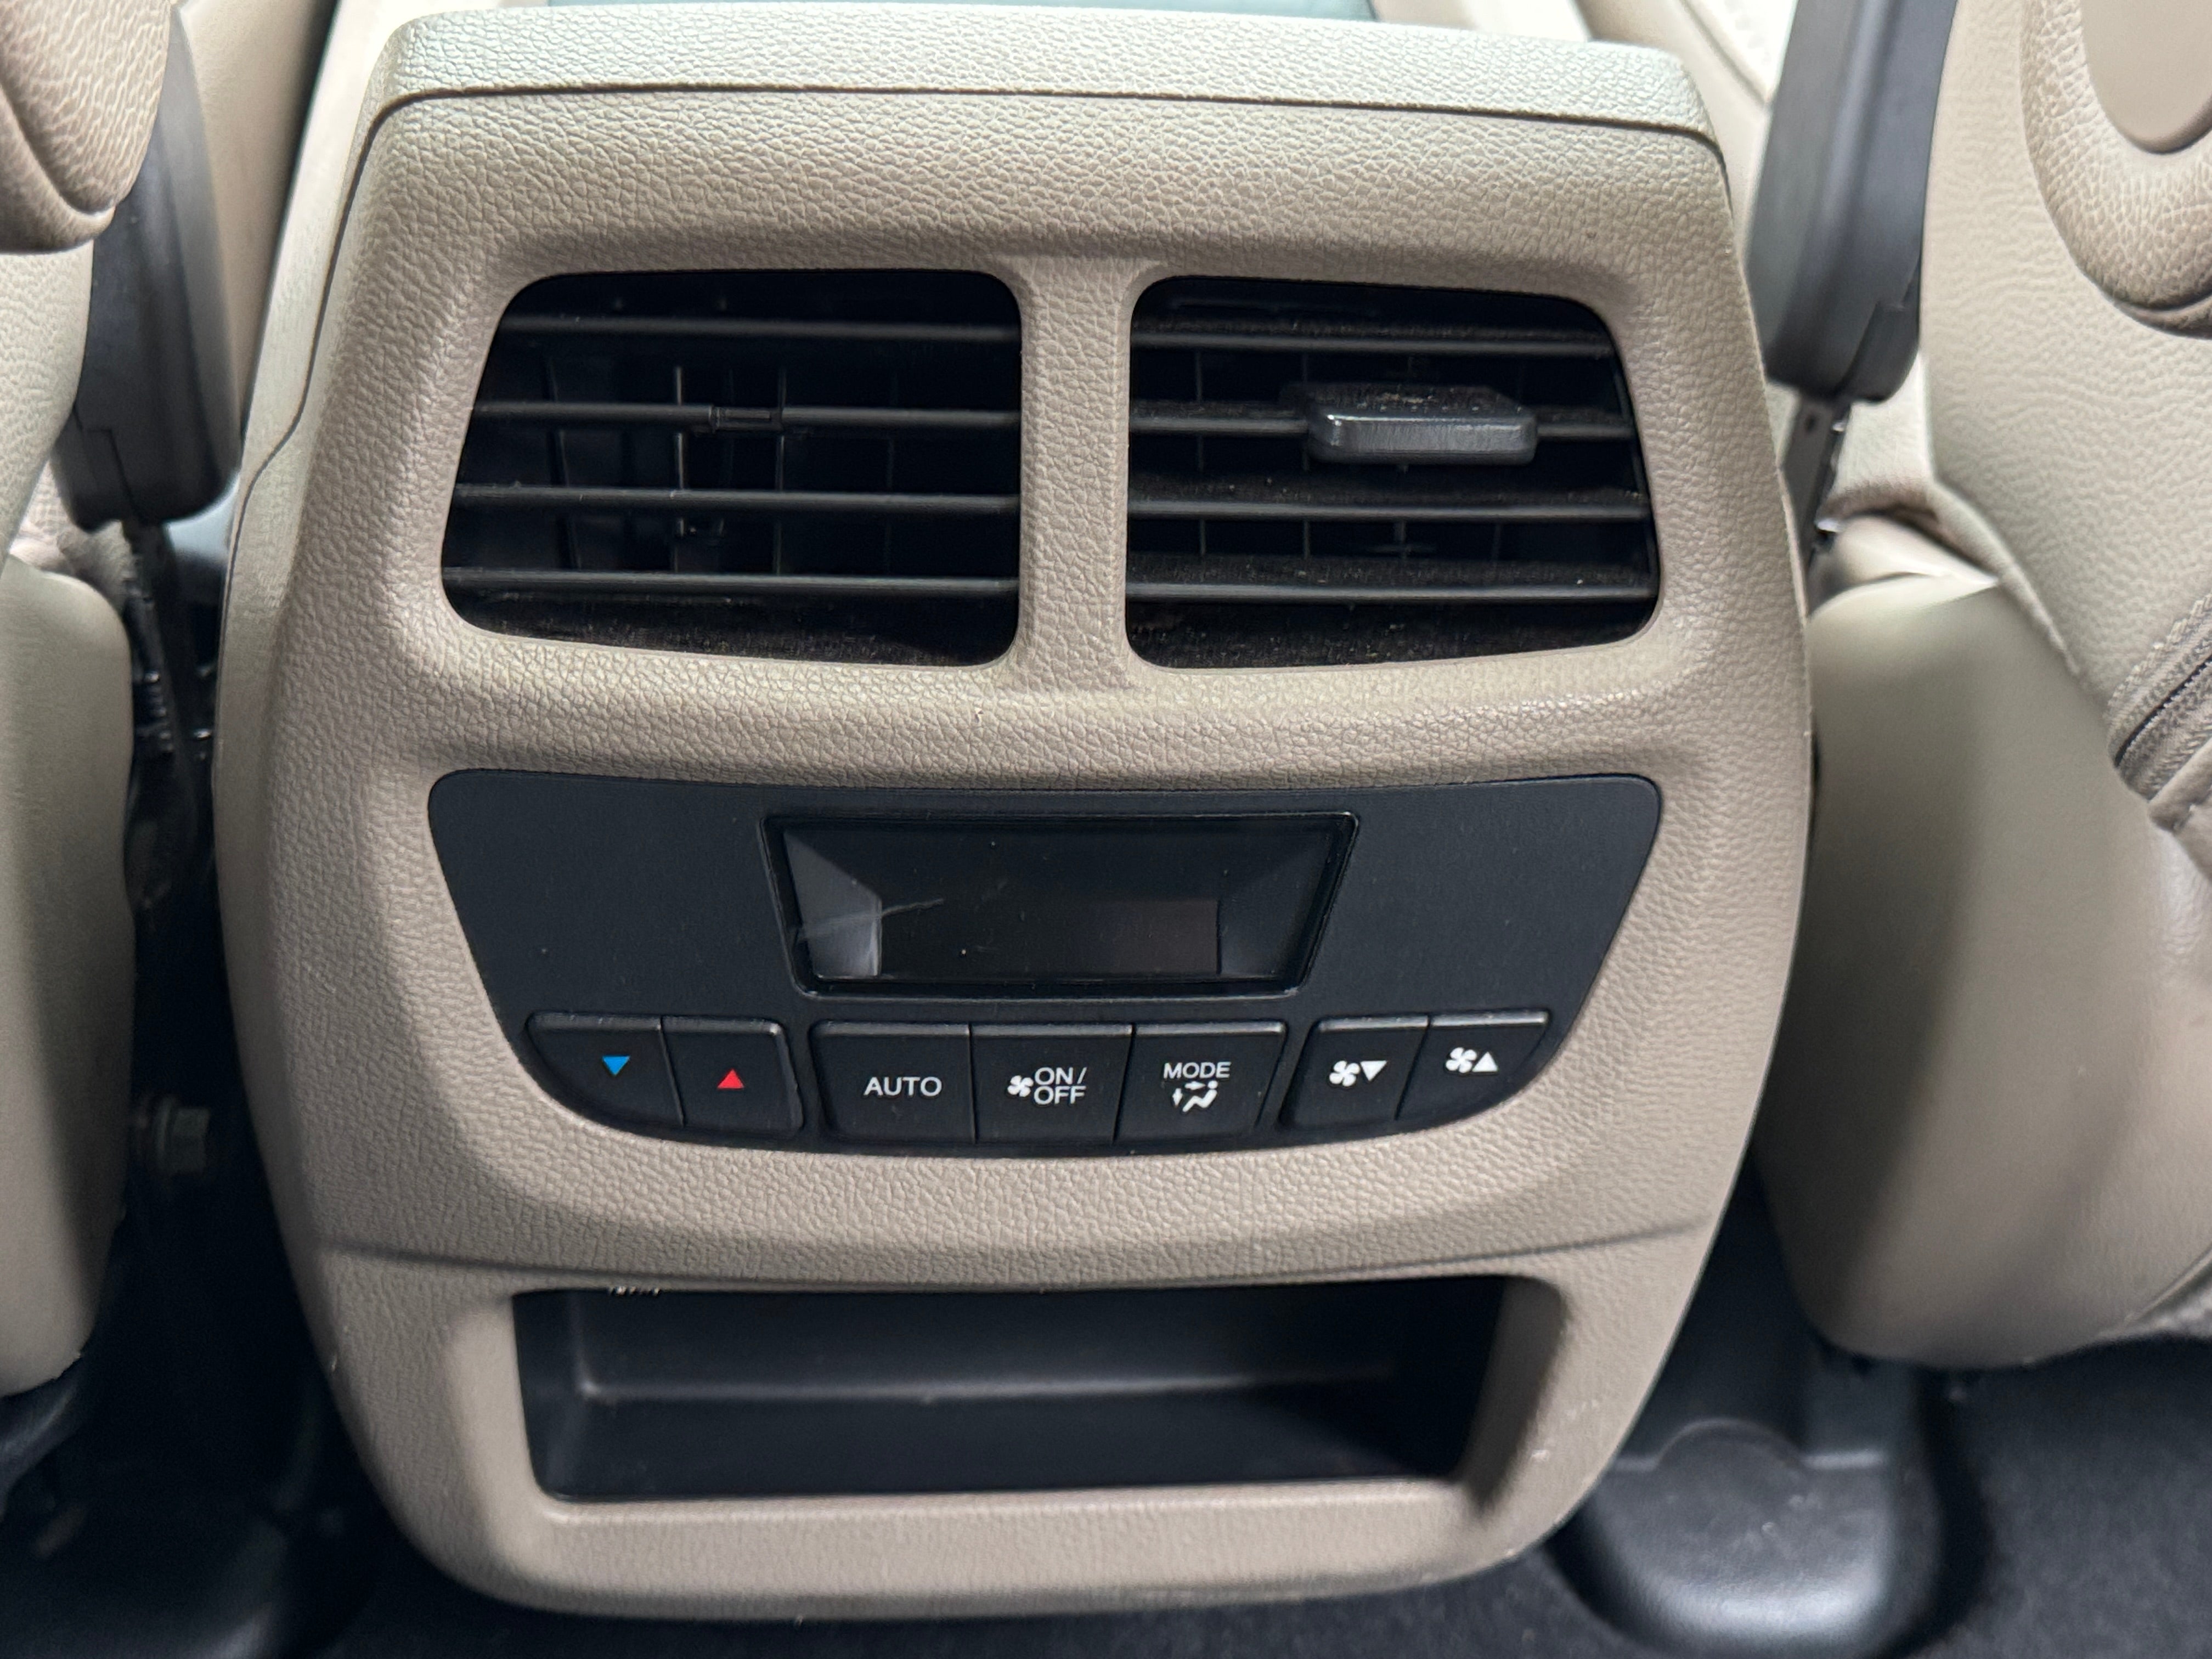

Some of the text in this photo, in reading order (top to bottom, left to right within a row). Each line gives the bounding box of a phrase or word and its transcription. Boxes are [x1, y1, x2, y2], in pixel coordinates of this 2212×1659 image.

[1034, 1066, 1087, 1085] ON/
[1163, 1062, 1231, 1079] MODE
[864, 1076, 943, 1097] AUTO
[1034, 1085, 1086, 1105] OFF
